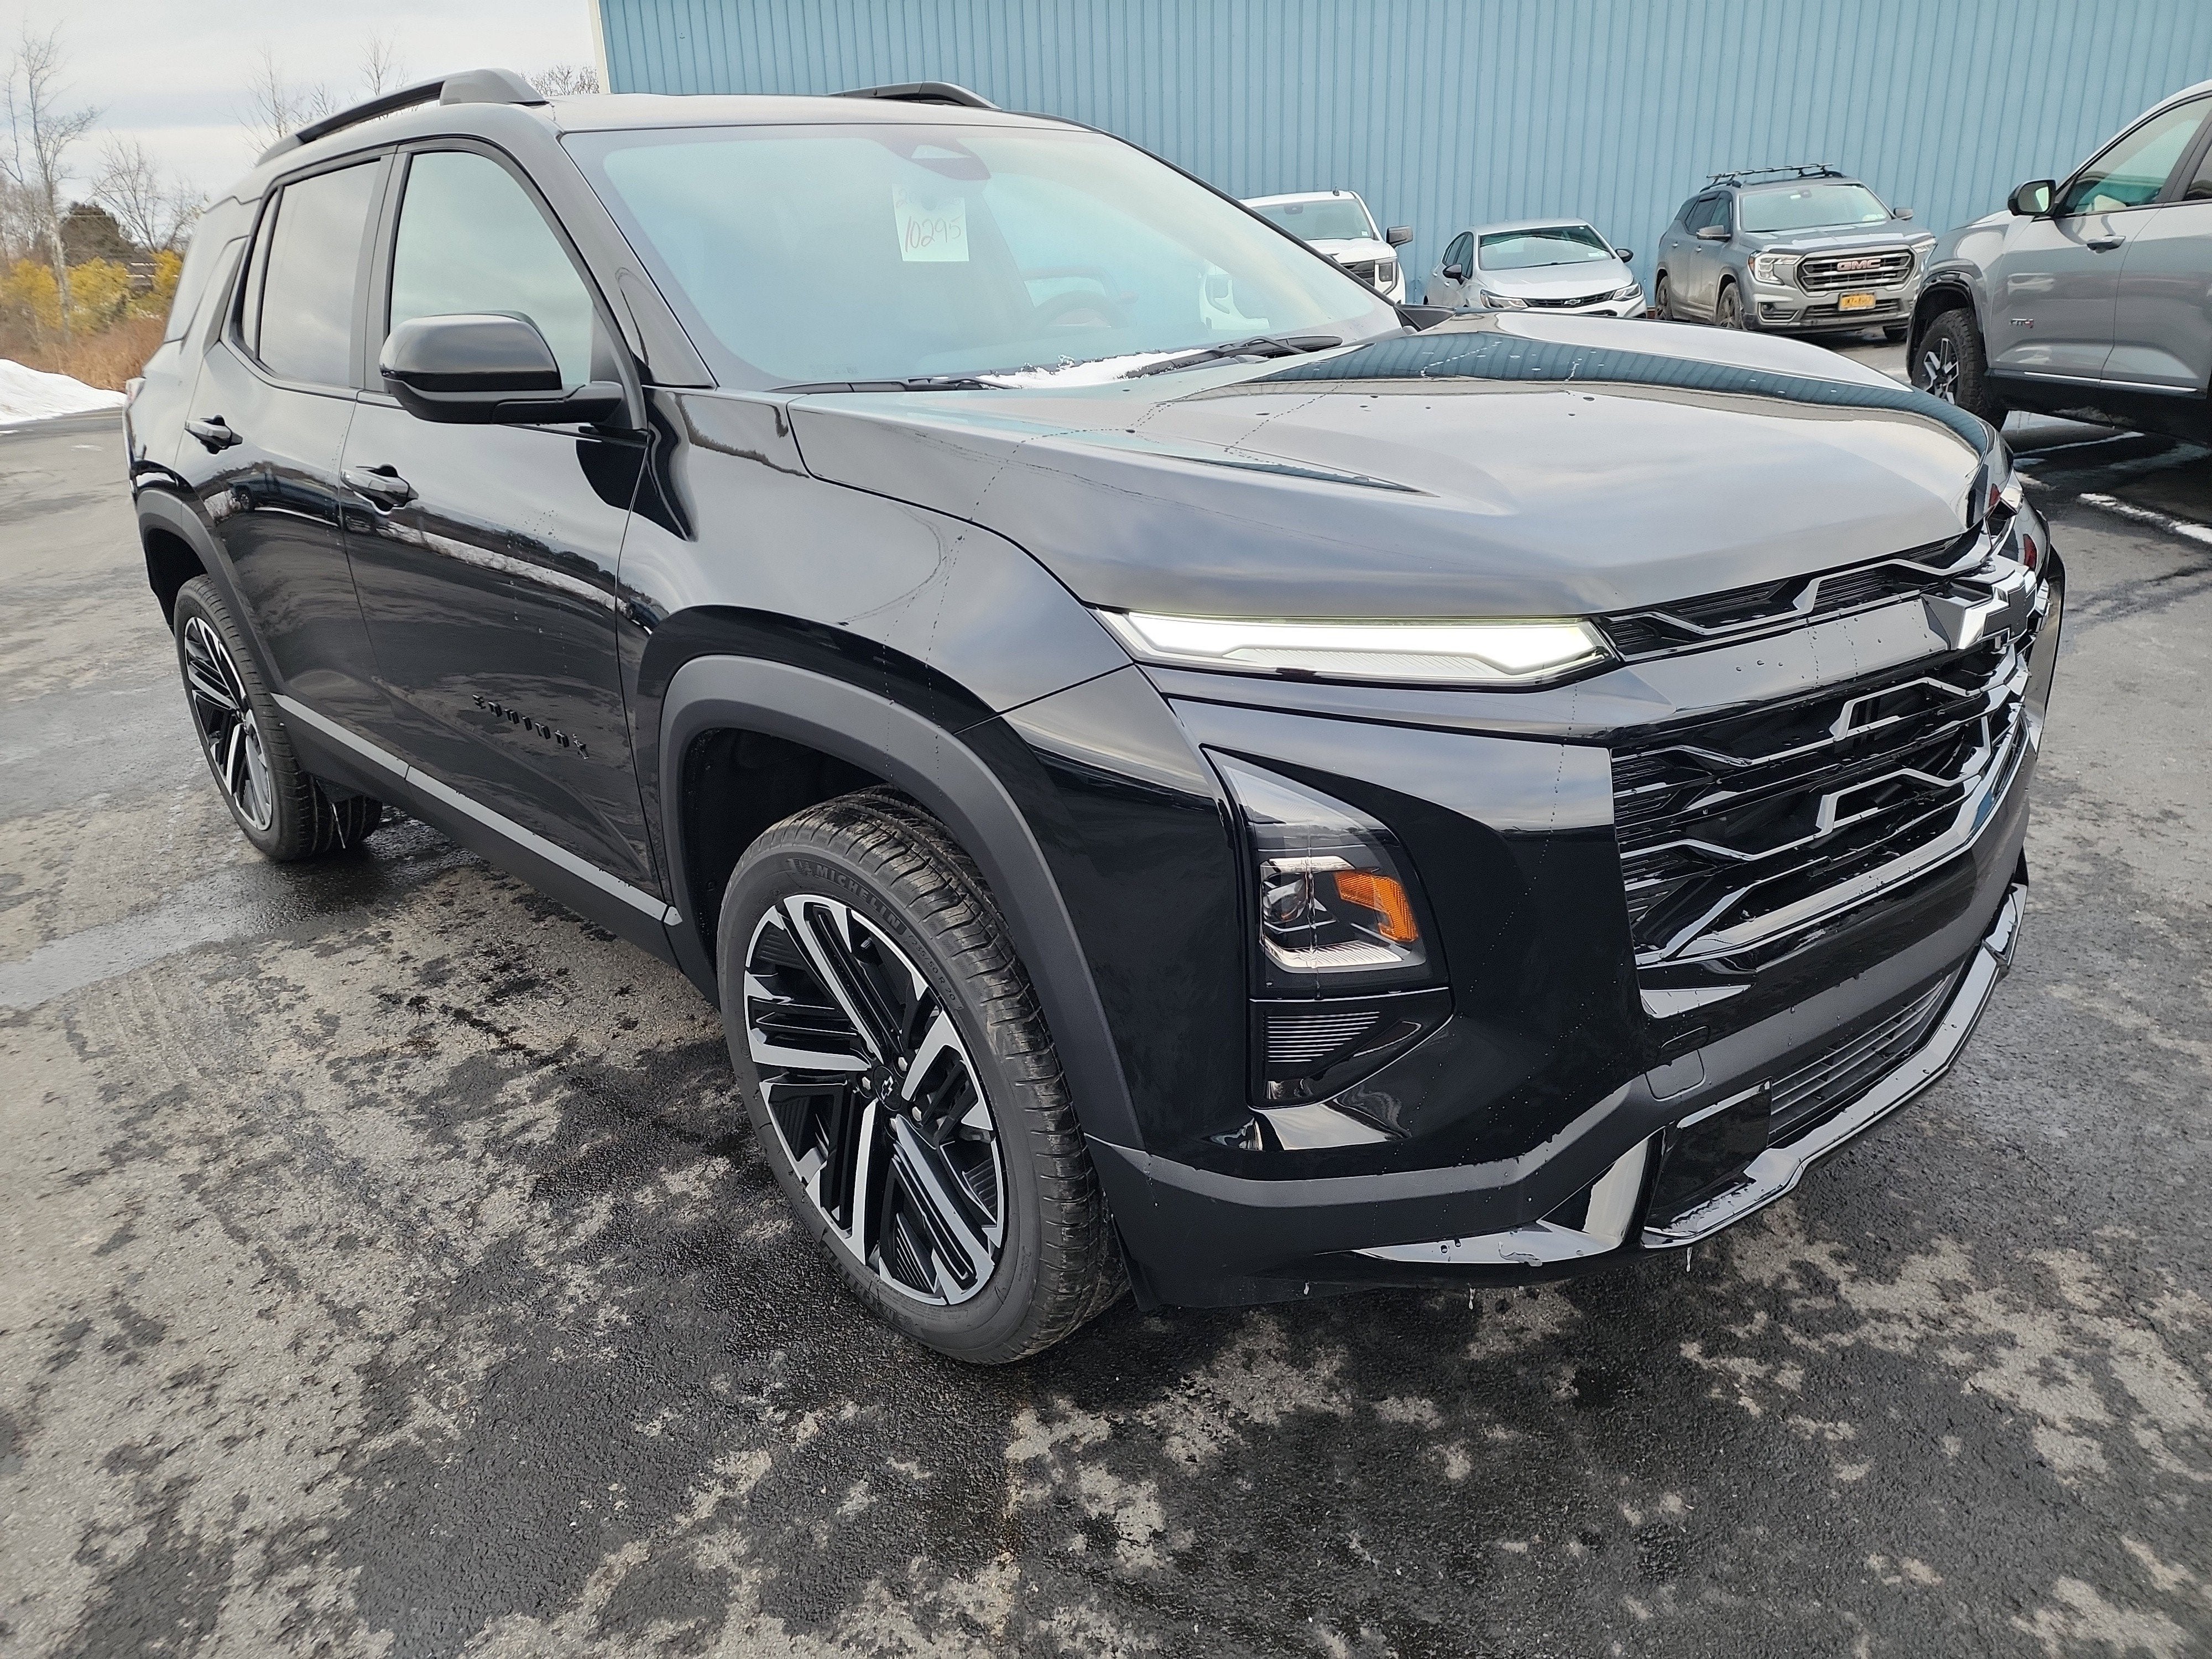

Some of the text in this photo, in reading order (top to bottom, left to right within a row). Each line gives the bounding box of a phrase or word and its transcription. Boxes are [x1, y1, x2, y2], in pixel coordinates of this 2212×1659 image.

[905, 215, 962, 252] 10295
[1838, 259, 1881, 270] GMC
[817, 864, 901, 929] MICHELIN
